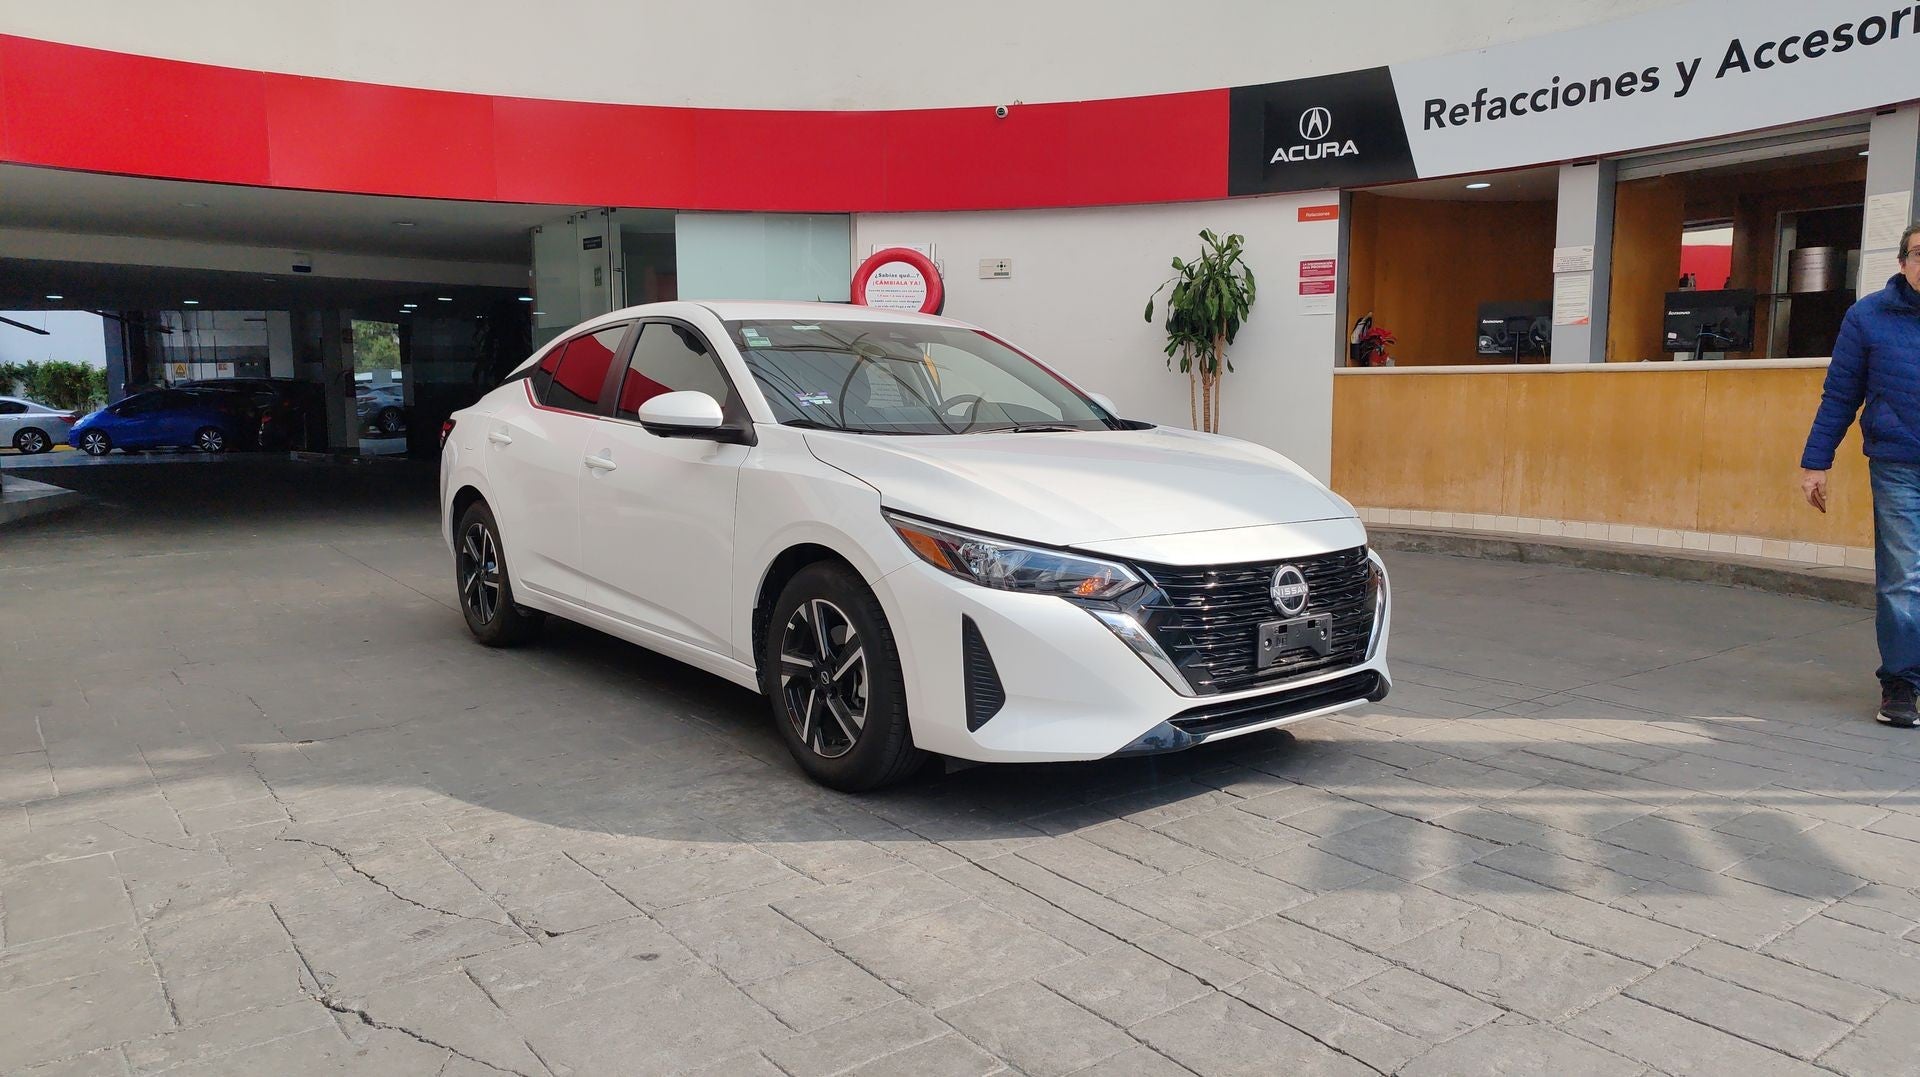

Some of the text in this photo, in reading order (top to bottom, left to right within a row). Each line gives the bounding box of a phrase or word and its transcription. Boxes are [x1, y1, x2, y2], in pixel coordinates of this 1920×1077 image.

[1423, 66, 1660, 131] Refacciones
[1673, 57, 1702, 98] y
[1269, 140, 1359, 164] ACURA
[1273, 584, 1309, 597] NISSAN
